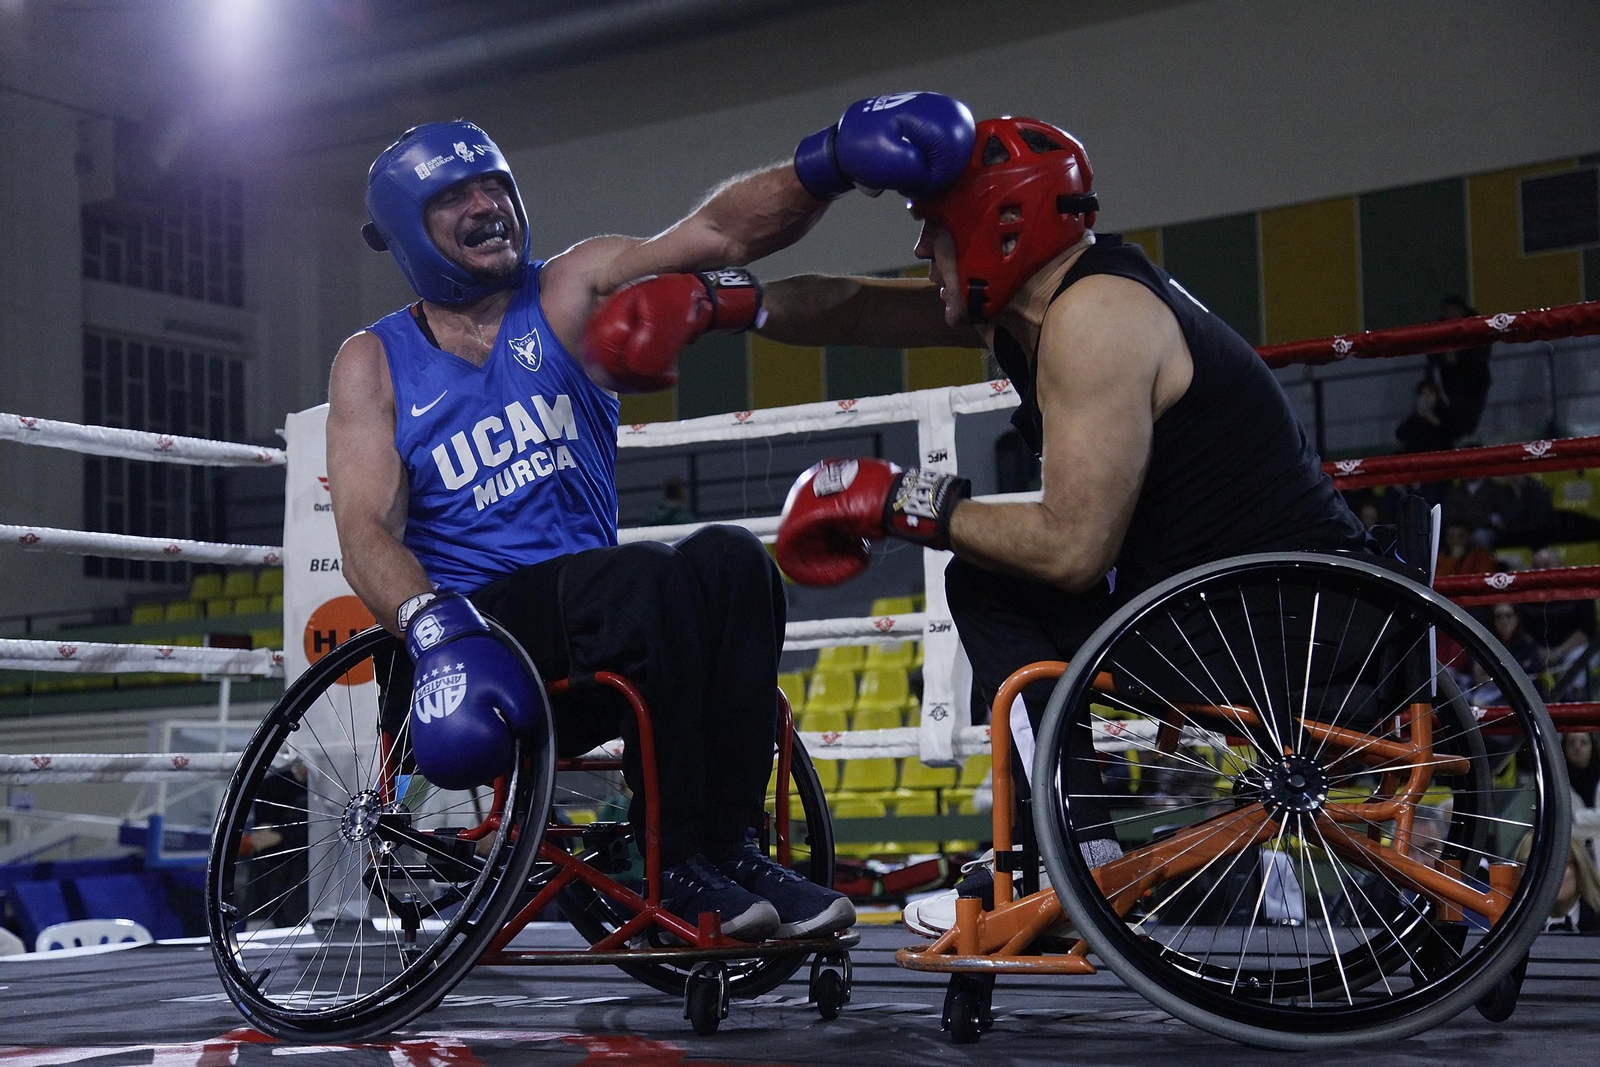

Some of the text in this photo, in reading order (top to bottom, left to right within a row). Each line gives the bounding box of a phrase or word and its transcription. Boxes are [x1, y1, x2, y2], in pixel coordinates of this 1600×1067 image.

[431, 394, 579, 491] UCAM
[928, 451, 948, 464] MFC
[473, 445, 577, 511] MURCIA
[310, 558, 343, 572] BEA
[929, 623, 952, 633] MFC
[415, 684, 467, 724] AM
